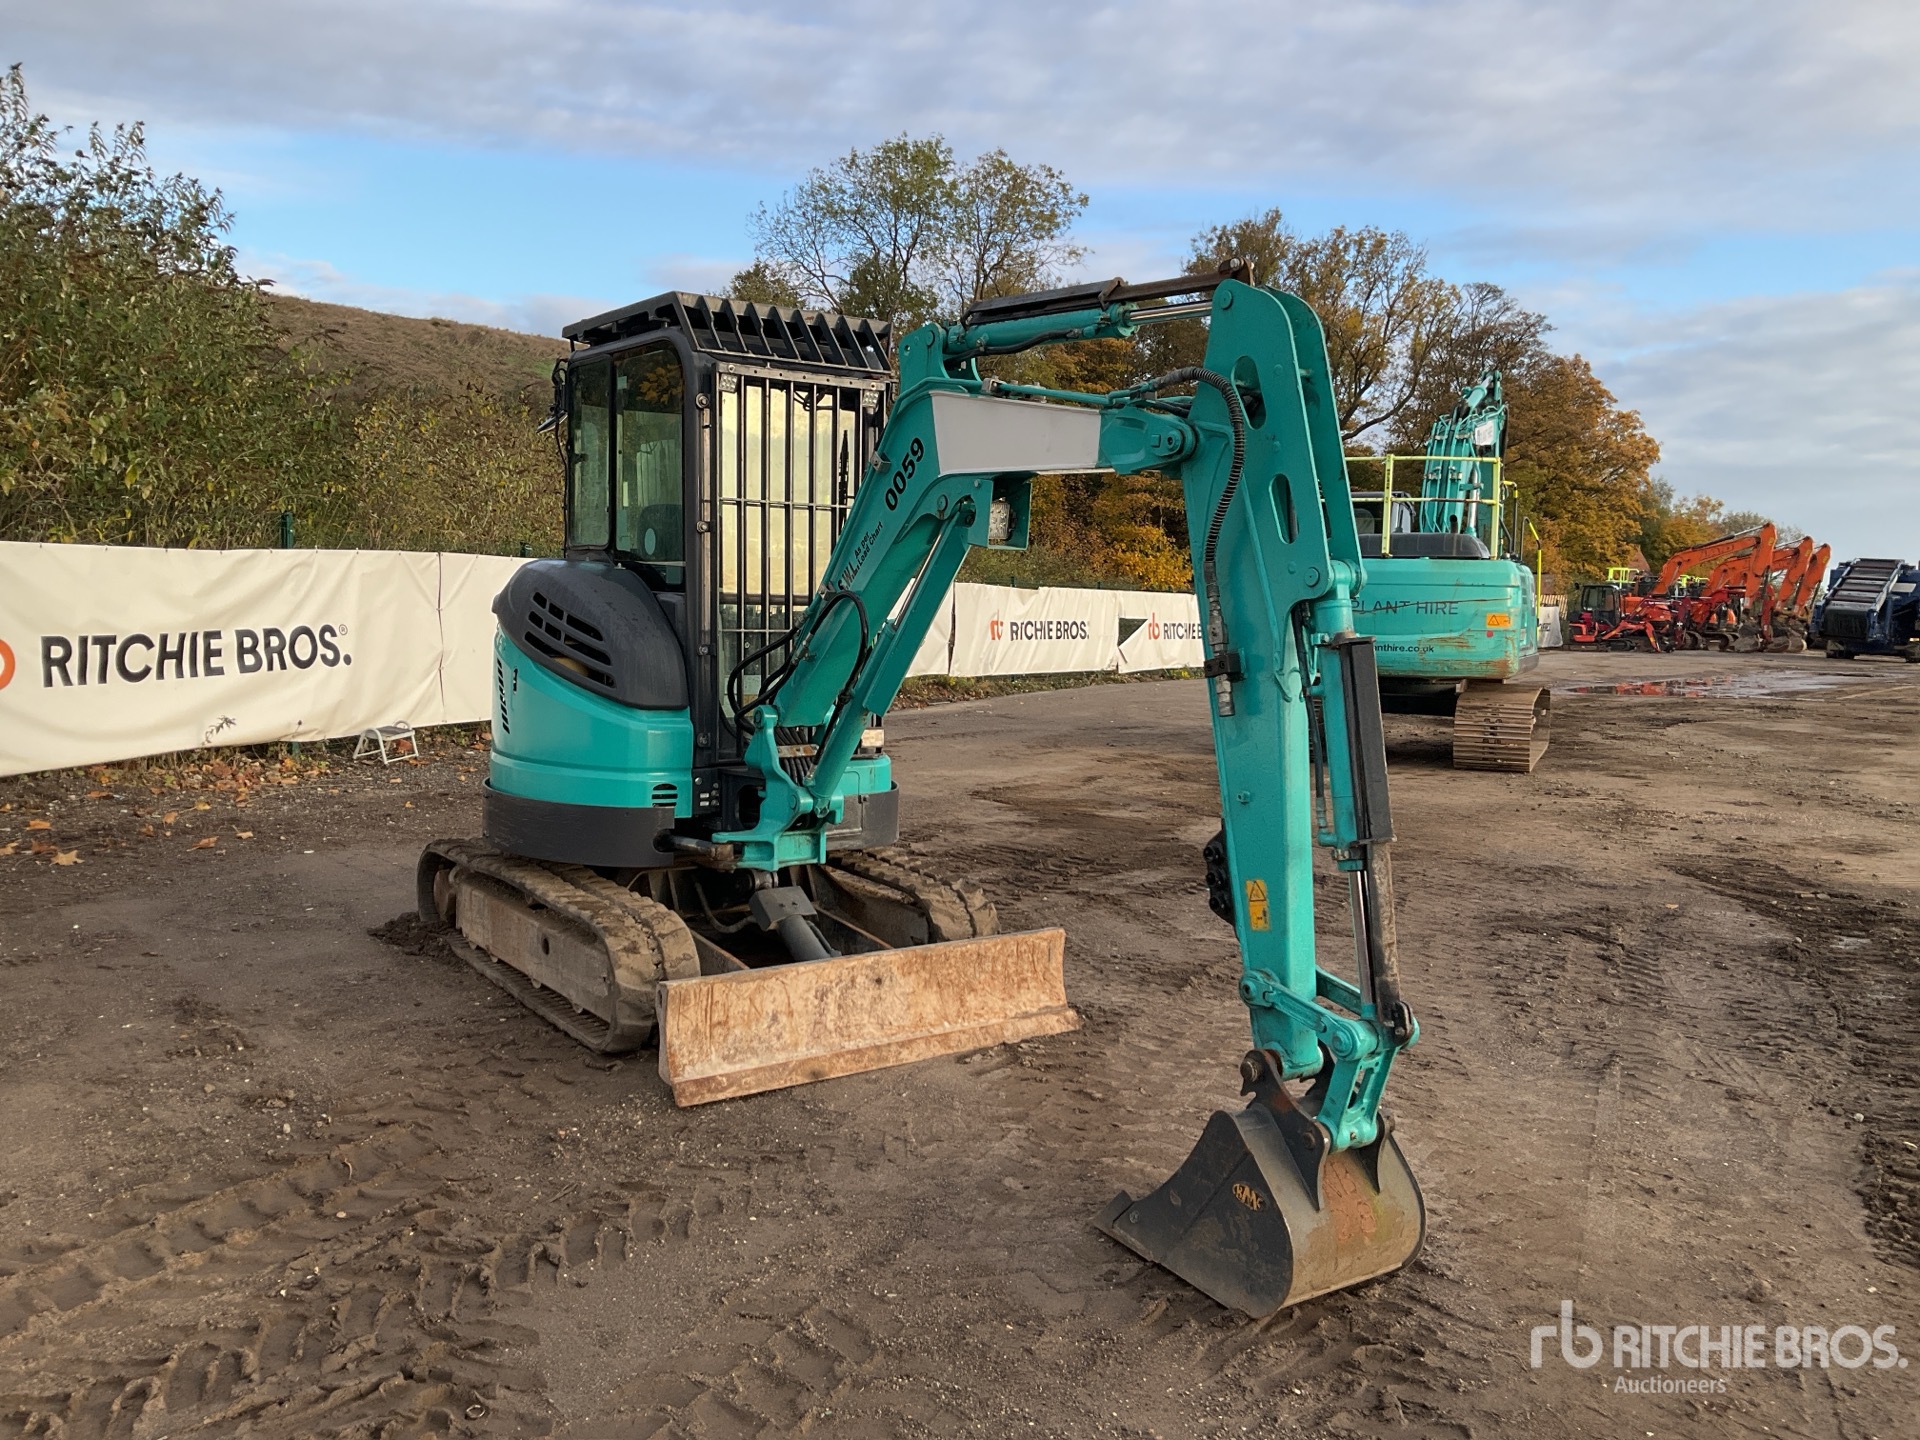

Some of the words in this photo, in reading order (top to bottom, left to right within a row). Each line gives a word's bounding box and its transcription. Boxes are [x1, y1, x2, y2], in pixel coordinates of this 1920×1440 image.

[885, 437, 924, 511] 0059
[858, 544, 871, 567] Load
[868, 520, 883, 546] Chart
[860, 531, 870, 549] per
[1351, 600, 1411, 614] PLANT
[1416, 601, 1459, 615] HIRE
[1010, 621, 1053, 641] RTCHIE
[1163, 622, 1196, 640] RITCHIE
[41, 629, 225, 688] RITCHIE
[235, 624, 352, 674] BROS.
